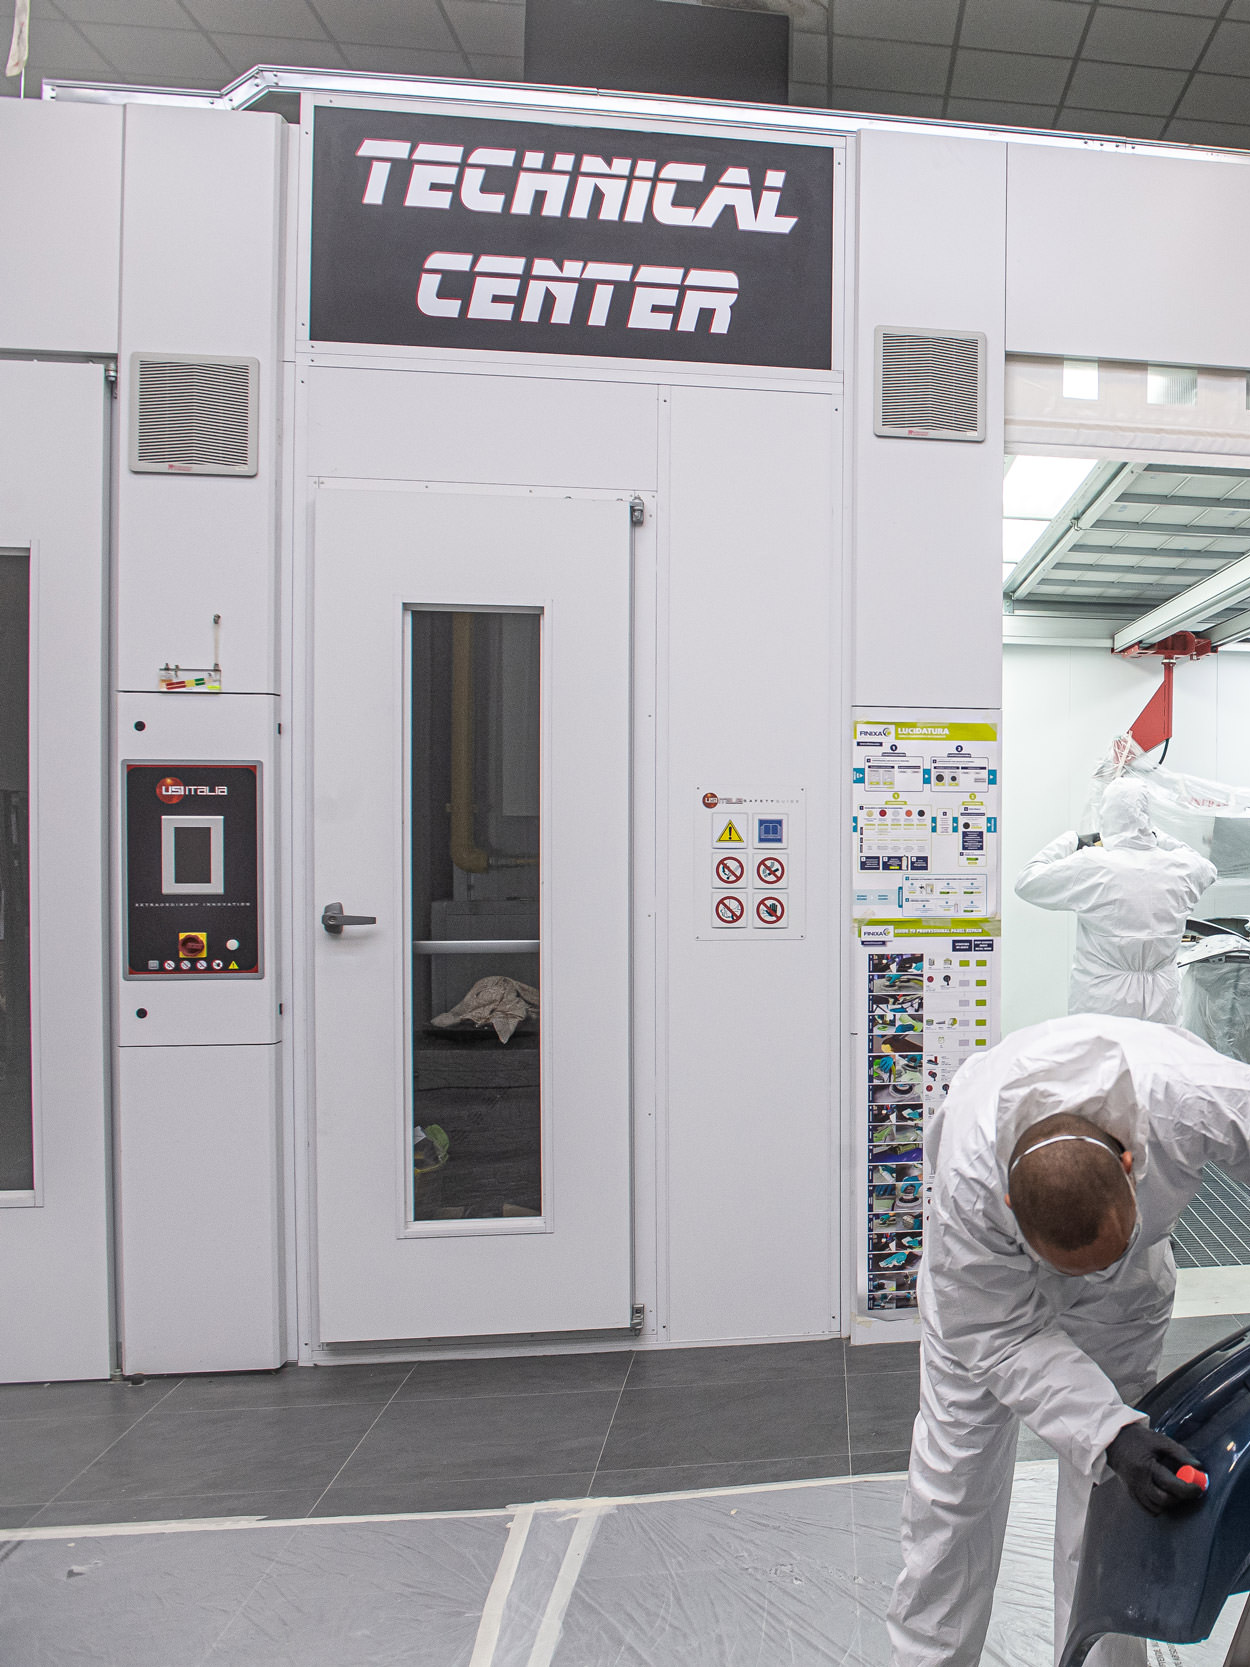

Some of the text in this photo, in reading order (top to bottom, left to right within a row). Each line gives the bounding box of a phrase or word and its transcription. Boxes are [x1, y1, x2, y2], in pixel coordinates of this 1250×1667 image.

[355, 137, 799, 234] TECHNICAL
[416, 251, 740, 335] CENTER
[897, 727, 950, 735] LUCIDATURA
[162, 785, 184, 796] USI
